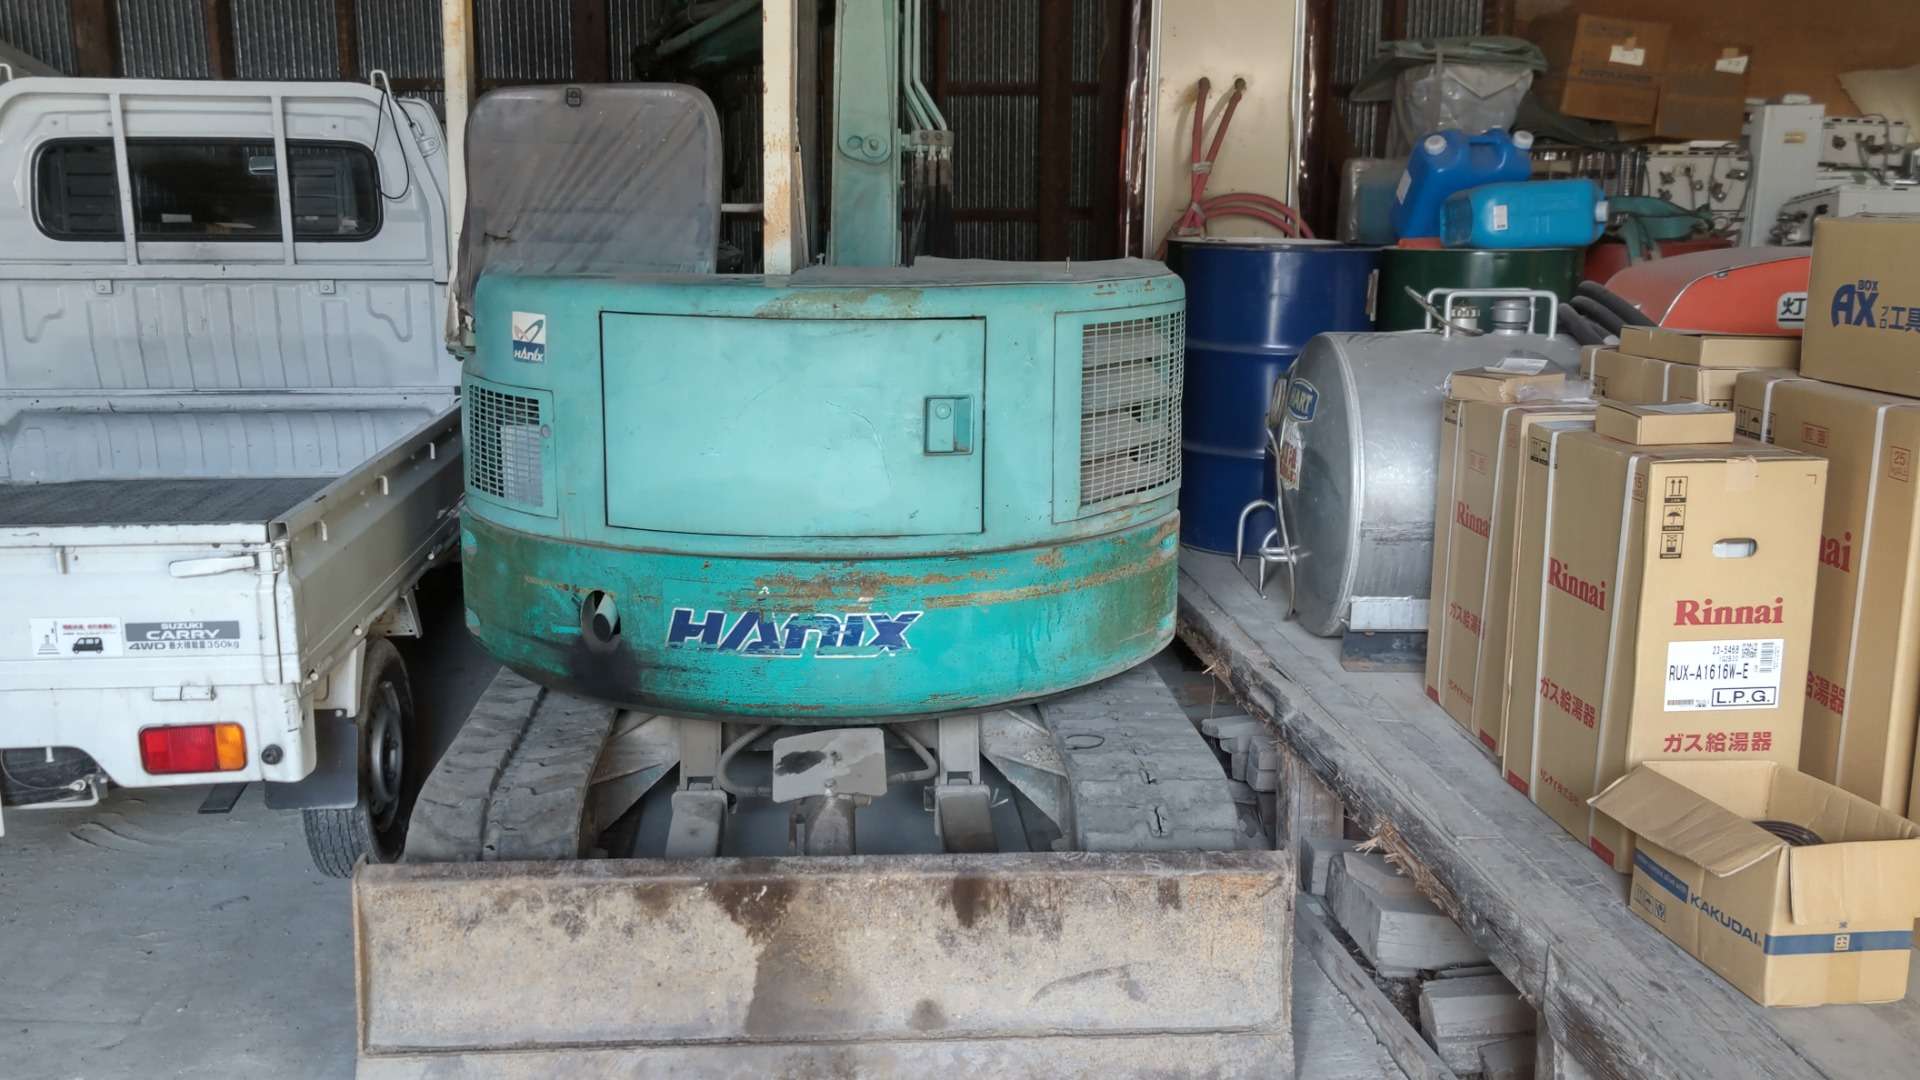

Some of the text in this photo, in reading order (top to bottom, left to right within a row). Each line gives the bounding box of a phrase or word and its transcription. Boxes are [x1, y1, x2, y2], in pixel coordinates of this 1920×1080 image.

[1857, 279, 1879, 290] BOX
[1831, 284, 1879, 328] AX
[1548, 556, 1606, 611] Rinnai
[1673, 596, 1784, 626] Rinnai
[146, 629, 220, 641] CARRY
[160, 622, 204, 630] SUZUKI
[128, 642, 166, 650] 4WD
[1668, 662, 1750, 681] RUX-A1616W-E
[1540, 676, 1596, 729] ガス給湯器
[1715, 689, 1771, 704] L.P.G.
[1663, 731, 1773, 753] ガス給湯器
[1690, 893, 1760, 945] KAKUDAI
